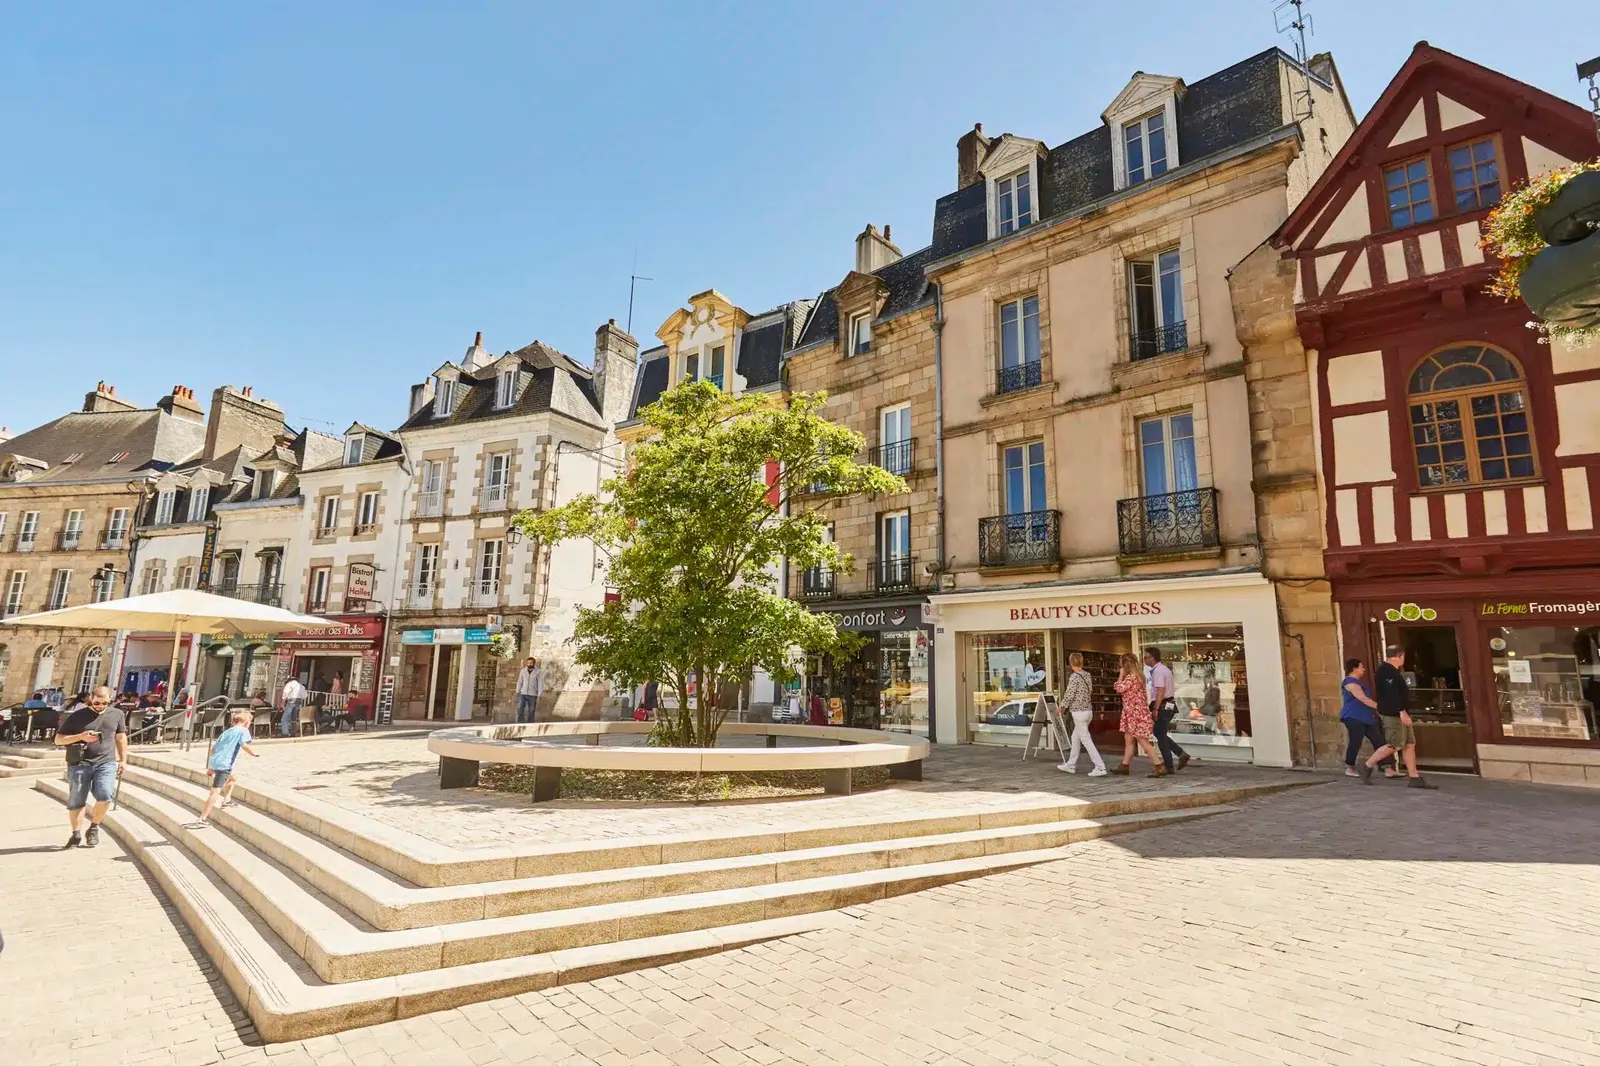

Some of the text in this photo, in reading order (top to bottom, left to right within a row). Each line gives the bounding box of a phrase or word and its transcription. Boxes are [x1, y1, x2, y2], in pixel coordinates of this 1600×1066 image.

[200, 528, 215, 588] PIZZERIA
[352, 567, 373, 576] Bistrot
[355, 577, 367, 586] des
[350, 587, 370, 597] Halles
[1010, 602, 1161, 620] BEAUTY SUCCESS
[1482, 603, 1495, 615] La
[1497, 603, 1527, 614] Ferme
[833, 610, 886, 627] Confort
[328, 626, 342, 636] des
